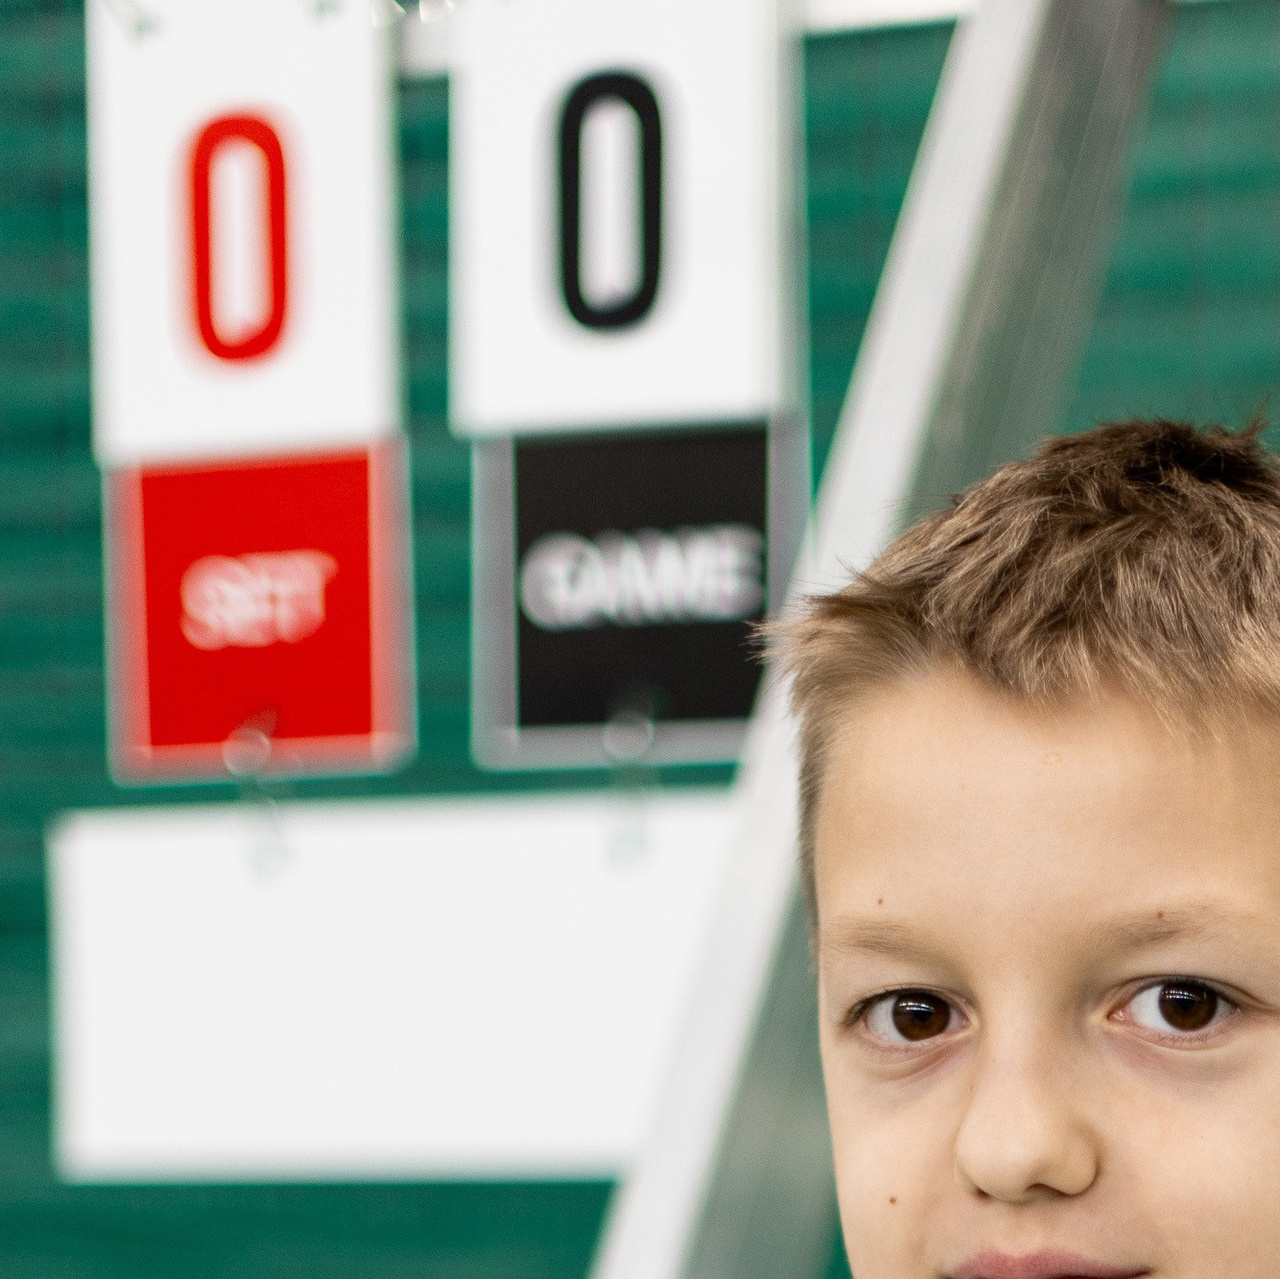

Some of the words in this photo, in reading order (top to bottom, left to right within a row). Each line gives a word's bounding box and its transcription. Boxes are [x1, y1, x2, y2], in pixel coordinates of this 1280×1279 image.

[187, 112, 289, 362] 0
[558, 71, 664, 329] 0
[521, 524, 766, 631] GAME
